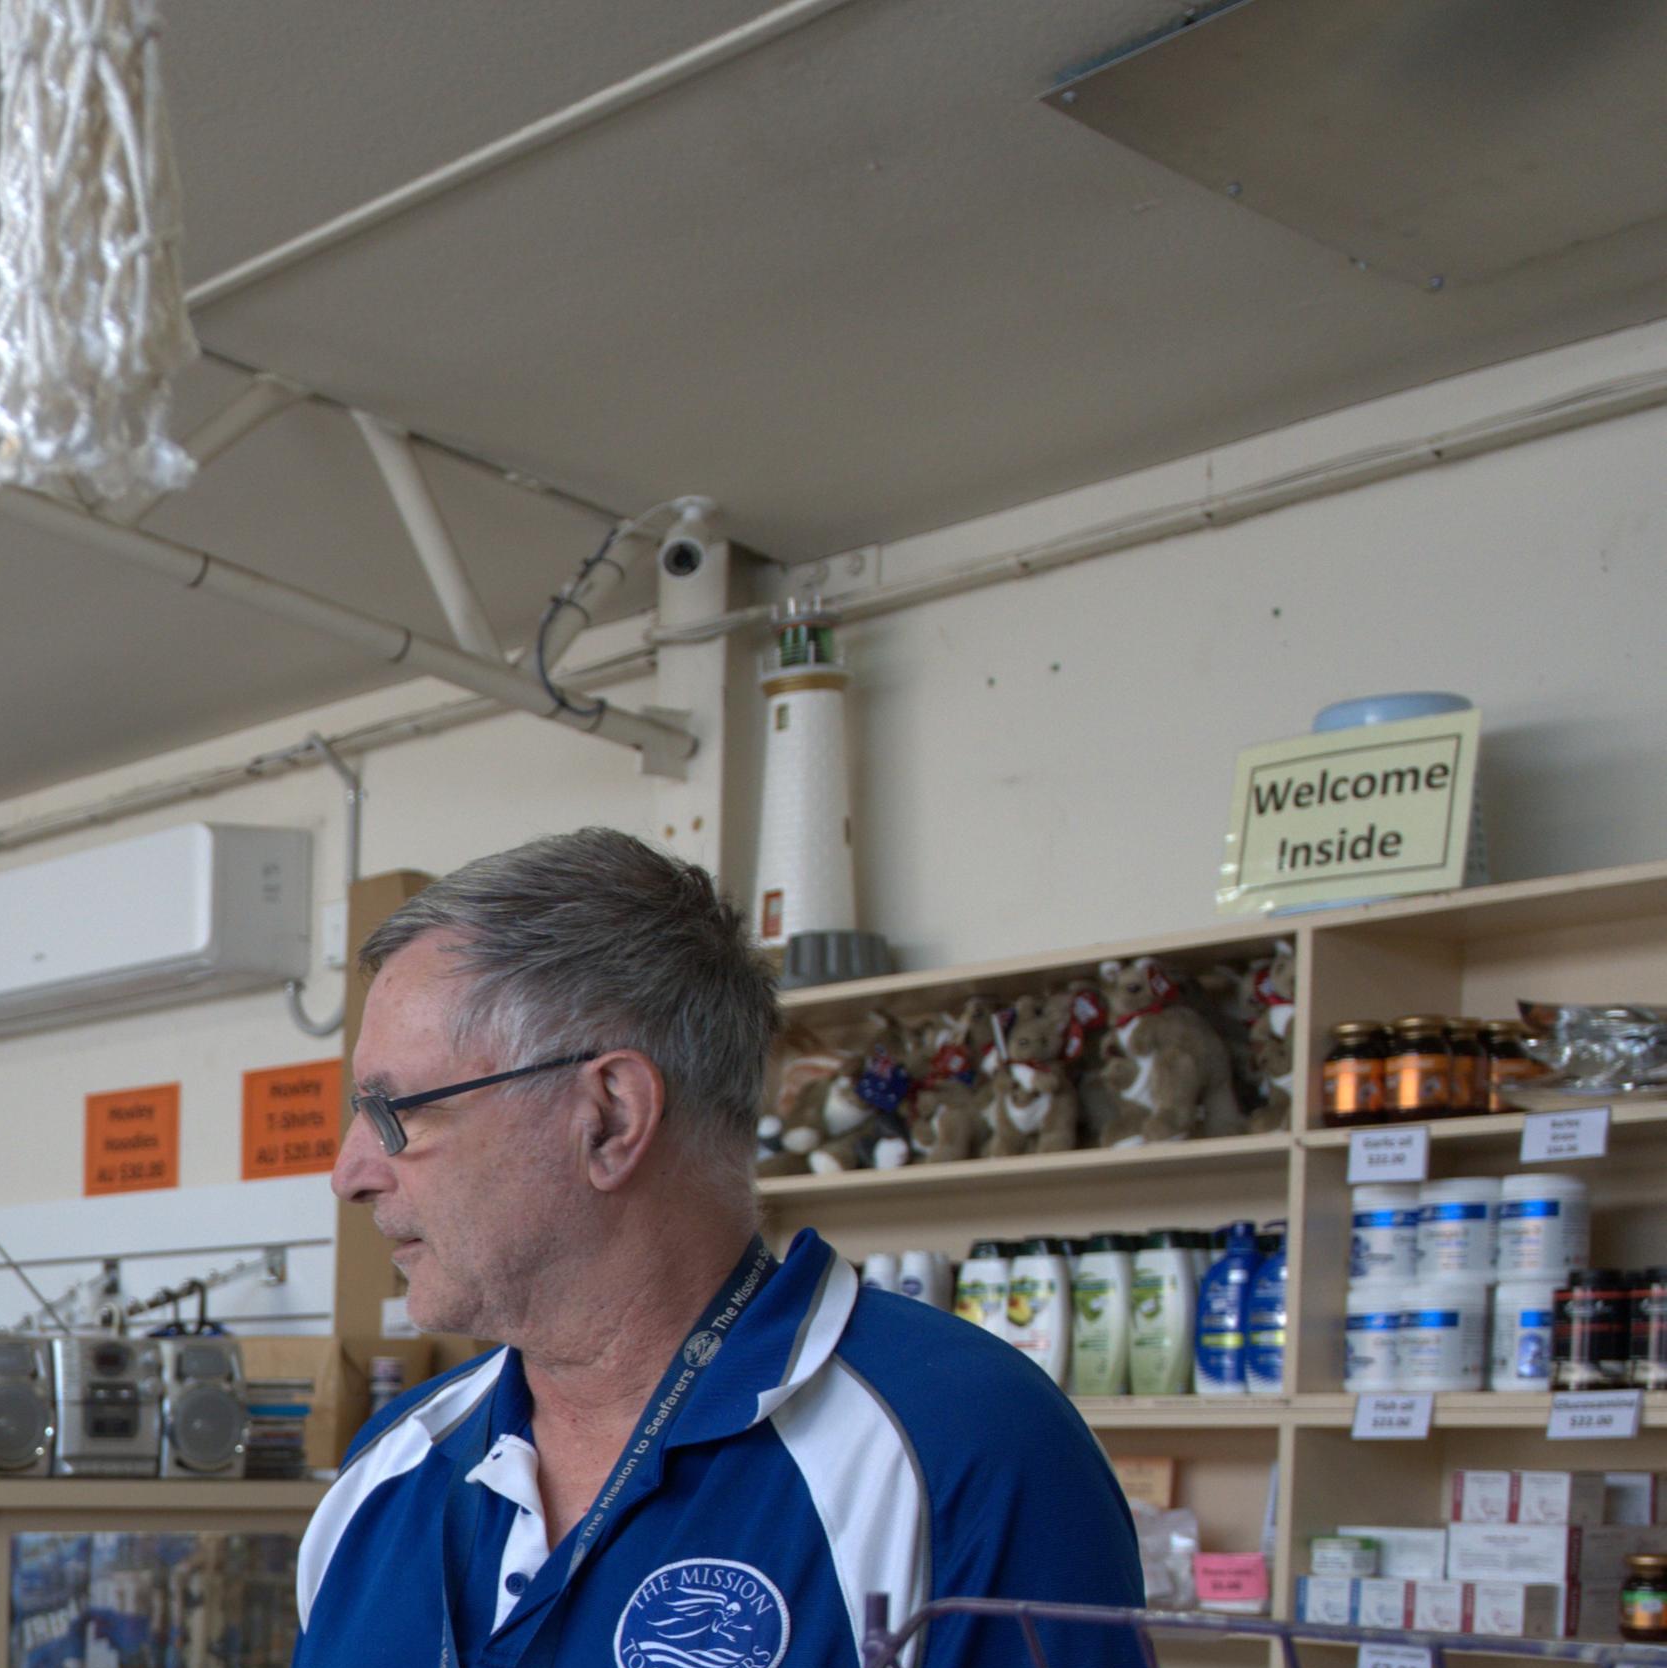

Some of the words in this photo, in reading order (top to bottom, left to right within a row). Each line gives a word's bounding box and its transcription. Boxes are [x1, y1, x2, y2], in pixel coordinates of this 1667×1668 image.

[1254, 761, 1450, 816] Welcome
[1277, 823, 1402, 872] Inside
[712, 1305, 739, 1332] The
[735, 1264, 765, 1310] Mission
[582, 1511, 607, 1539] The
[600, 1455, 639, 1511] Mission
[634, 1437, 650, 1458] to
[645, 1368, 698, 1441] Seafarers
[632, 1571, 673, 1612] THE
[680, 1566, 774, 1617] MISSION
